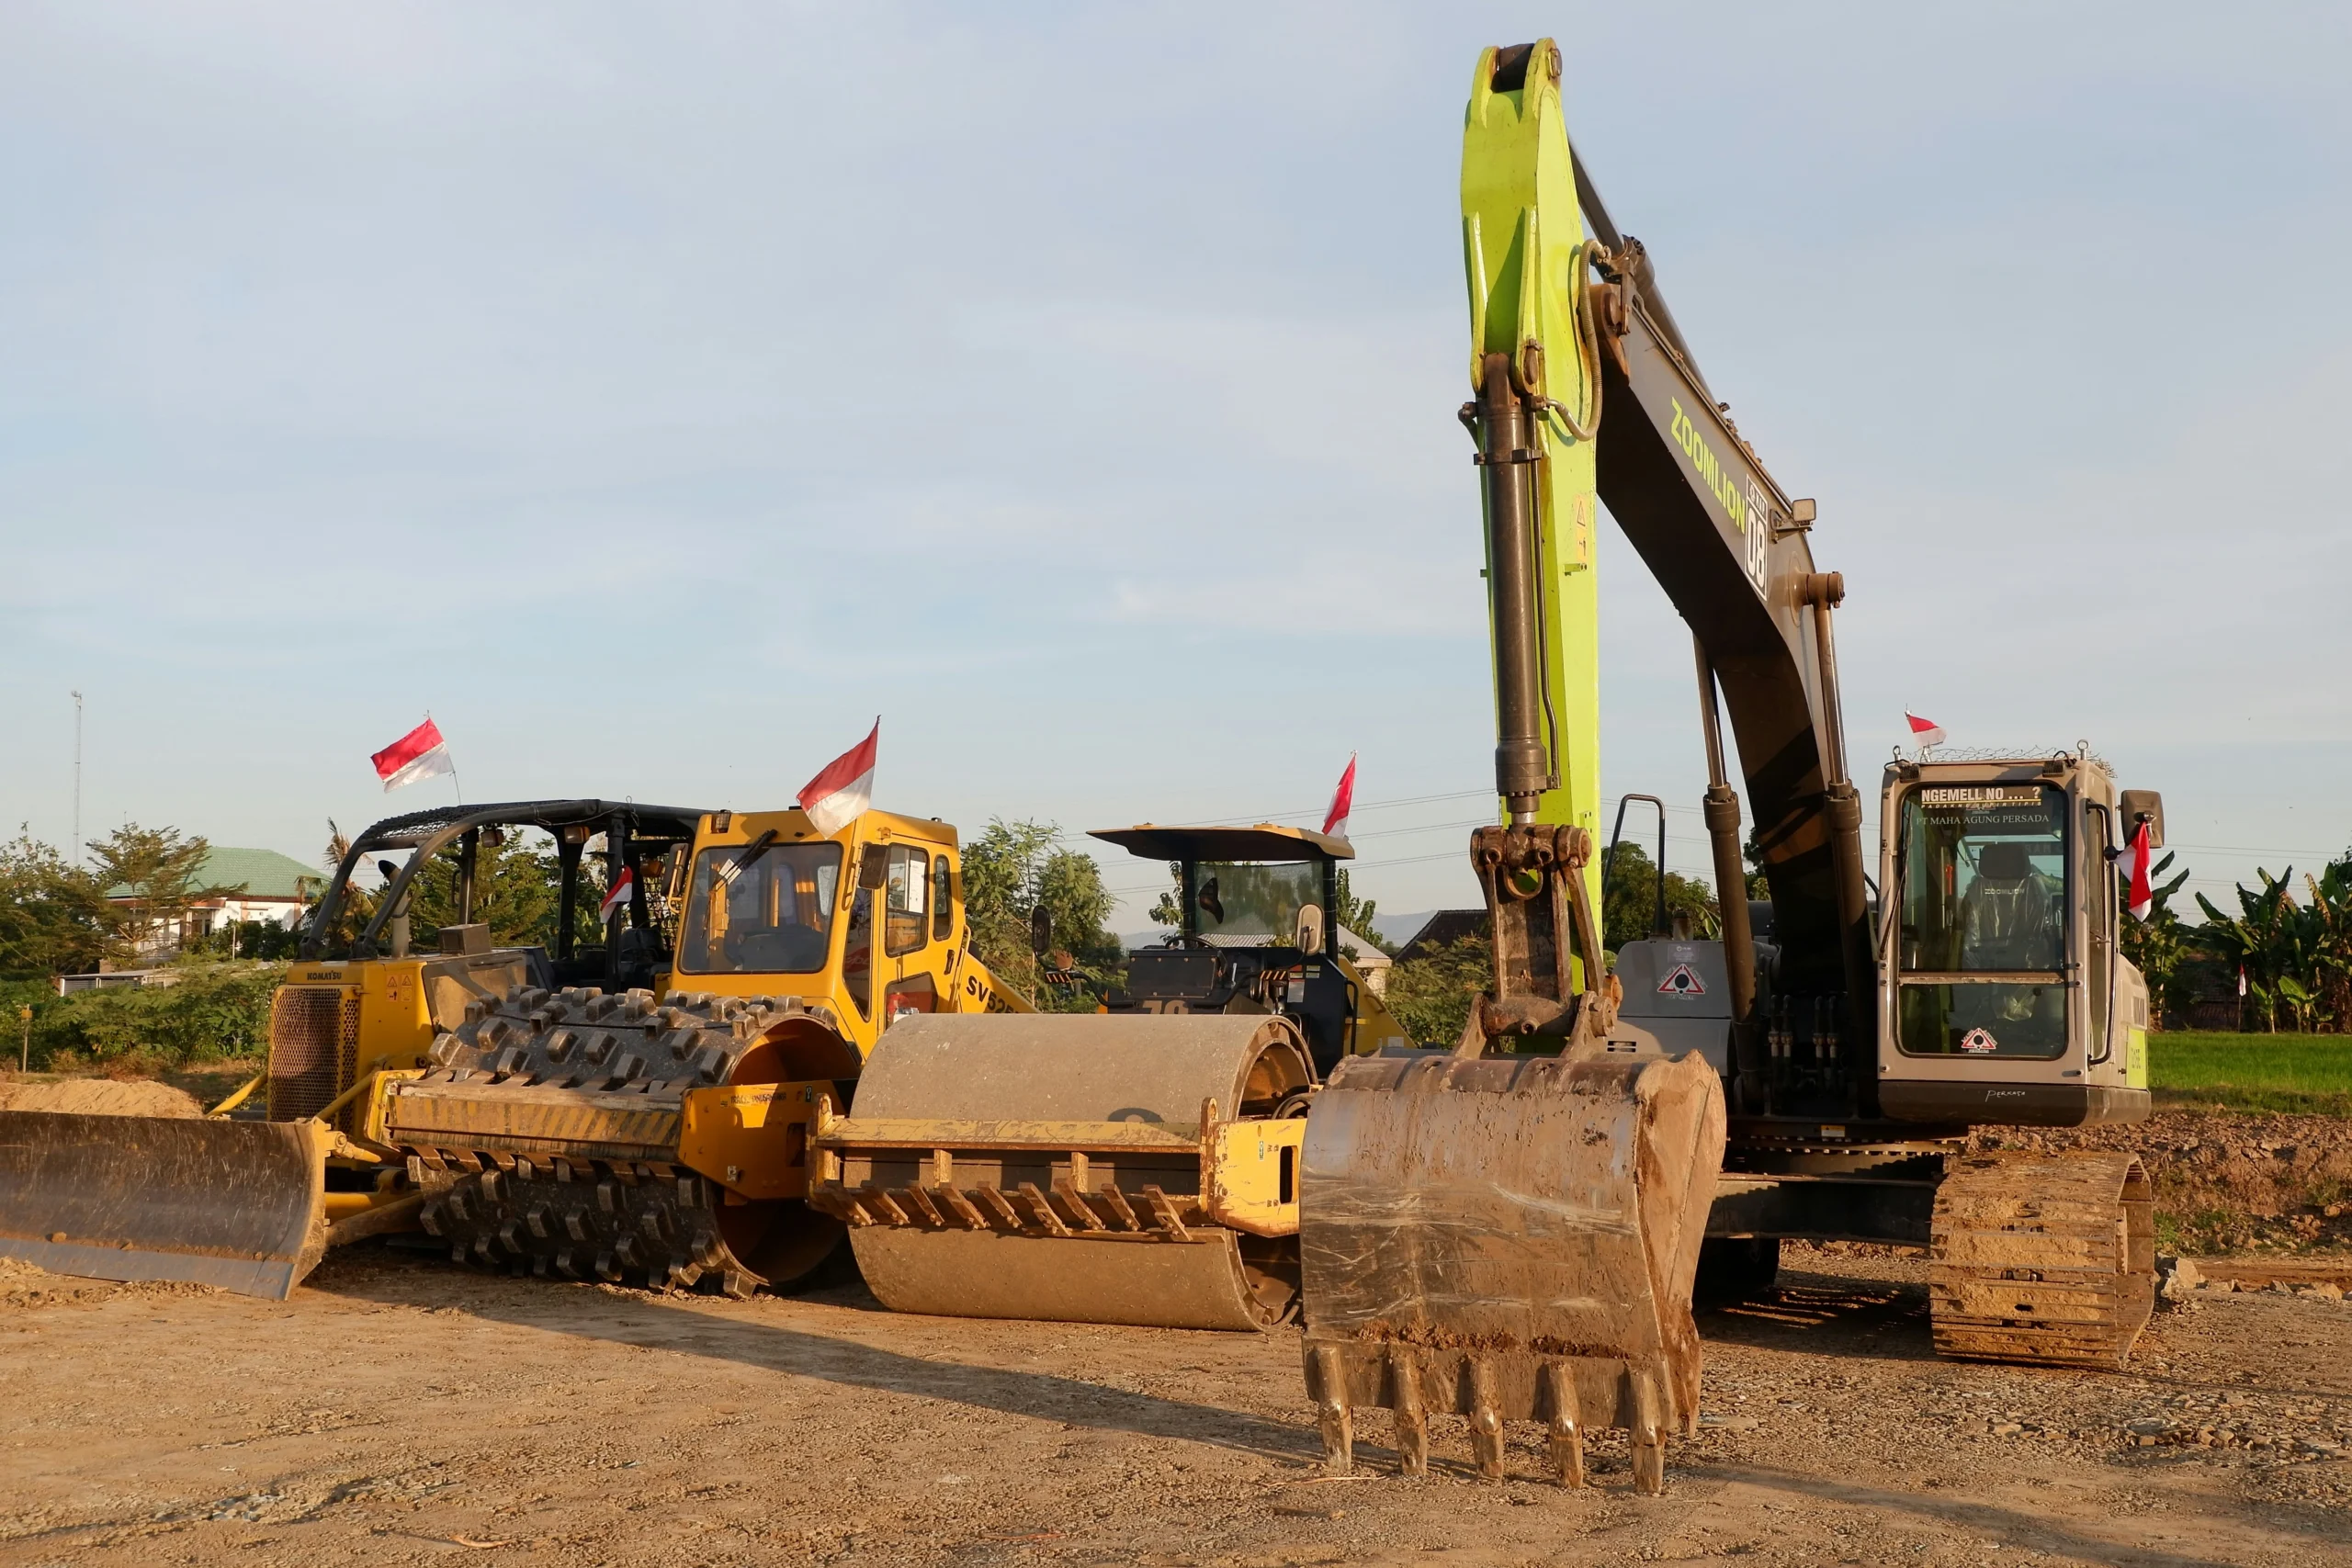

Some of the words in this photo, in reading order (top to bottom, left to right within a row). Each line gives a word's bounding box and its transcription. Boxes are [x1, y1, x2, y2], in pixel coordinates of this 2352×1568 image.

[1670, 396, 1746, 534] ZOOMLION
[1747, 507, 1767, 589] 08
[1921, 788, 1982, 802] NGEMELL
[1985, 787, 2004, 800] NO
[1917, 817, 1928, 825] PT
[1930, 817, 1961, 825] MAHA
[1963, 815, 2000, 824] AGUNG
[2003, 814, 2050, 823] PERSADA
[307, 970, 342, 980] KOMATSU
